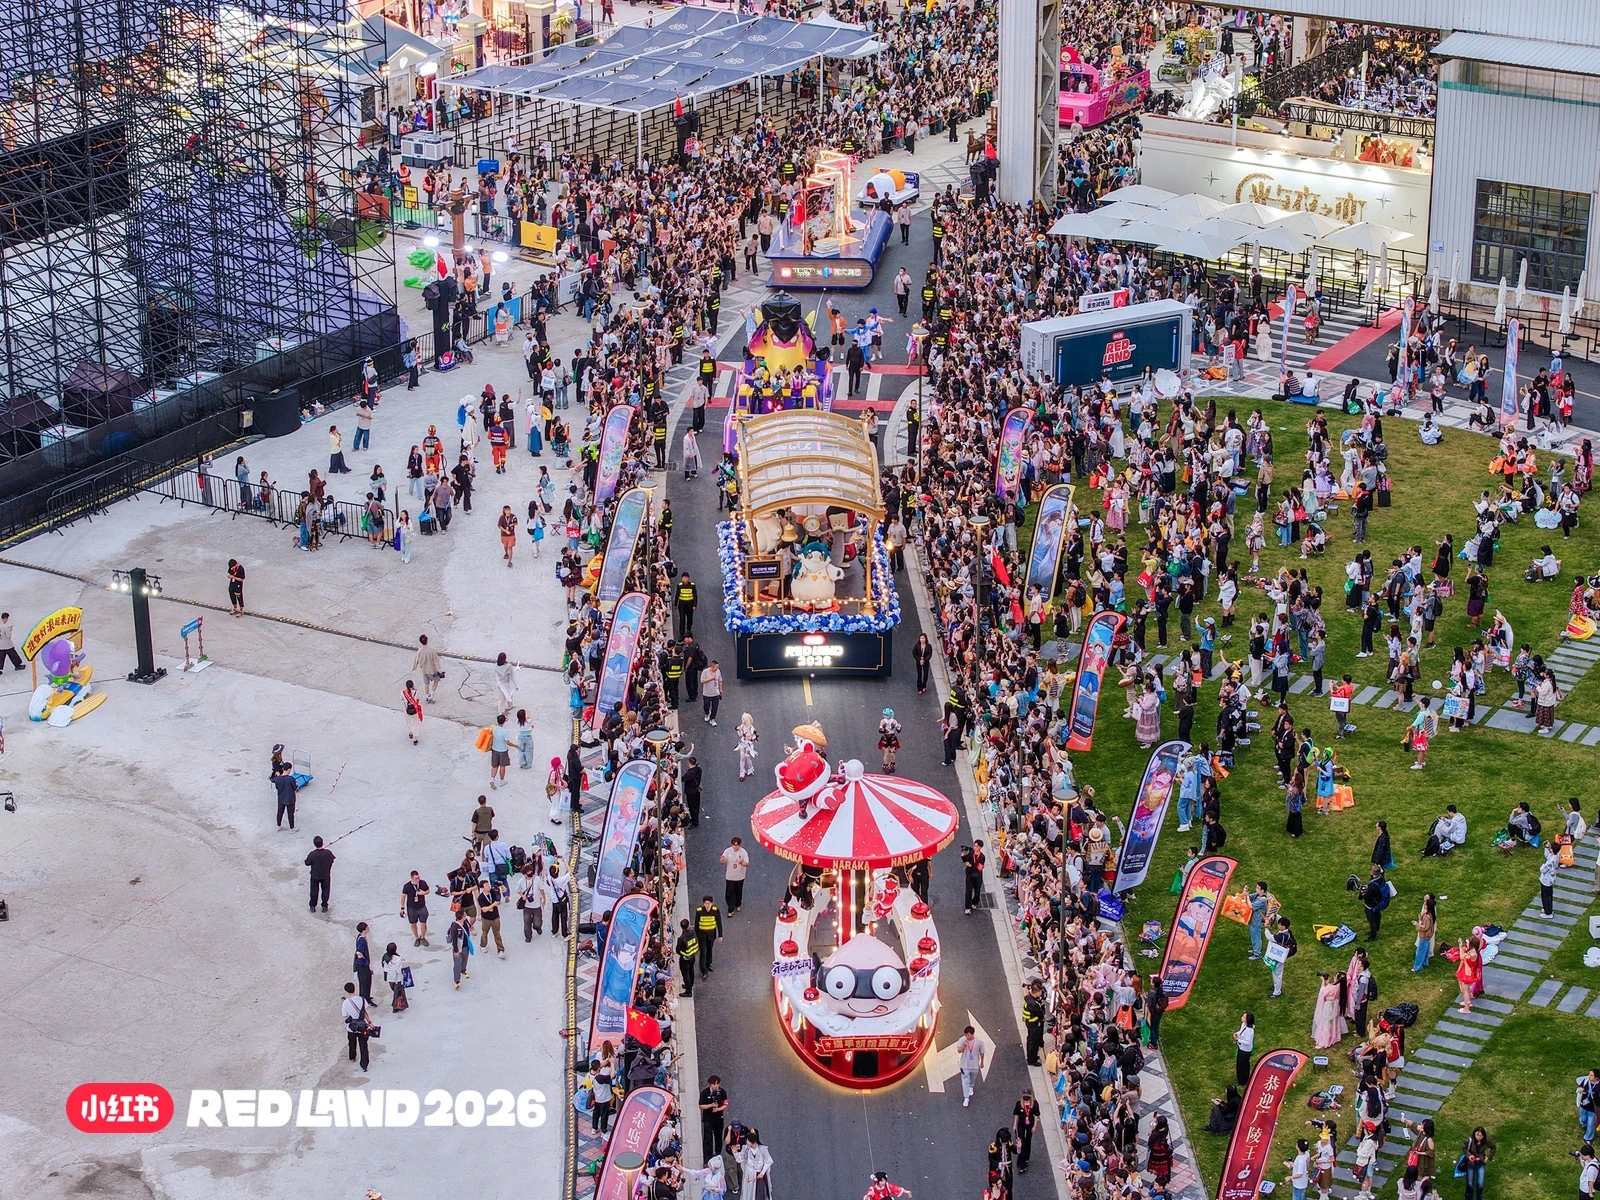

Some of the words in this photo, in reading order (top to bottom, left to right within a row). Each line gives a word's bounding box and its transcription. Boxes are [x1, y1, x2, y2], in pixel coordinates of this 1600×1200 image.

[1106, 339, 1130, 354] RED
[1103, 349, 1131, 365] LAND
[797, 656, 832, 666] 2026
[774, 846, 803, 865] NARAKA
[833, 860, 870, 871] NARAKA
[891, 851, 924, 867] NARAKA
[1241, 1074, 1280, 1161] 恭迎广陵王
